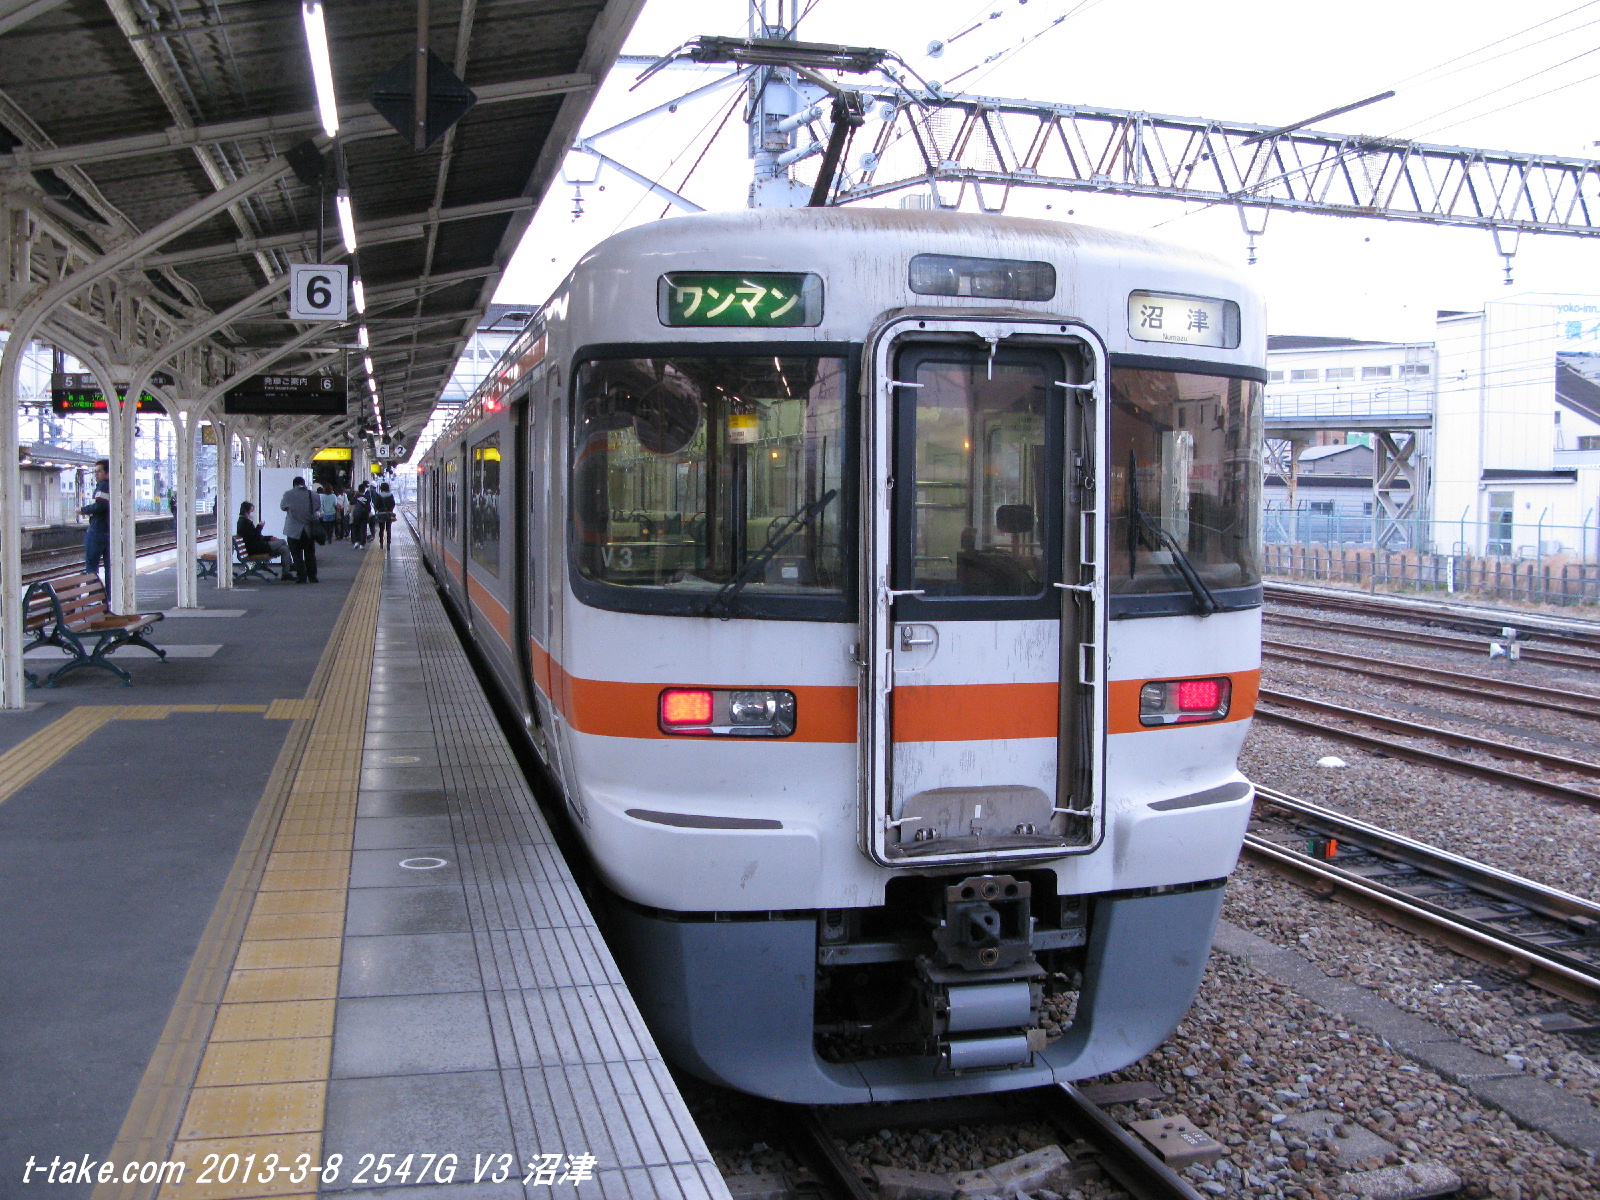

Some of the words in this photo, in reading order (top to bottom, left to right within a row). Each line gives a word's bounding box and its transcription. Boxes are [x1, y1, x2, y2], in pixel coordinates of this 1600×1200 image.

[306, 275, 332, 309] 6
[676, 286, 799, 318] ワンマン
[1140, 304, 1210, 333] 沼津
[1162, 332, 1188, 342] Numazu
[64, 377, 73, 387] 5
[264, 377, 308, 386] 発車ご案内
[323, 379, 332, 390] 6
[379, 446, 386, 455] 6
[397, 446, 404, 455] 2
